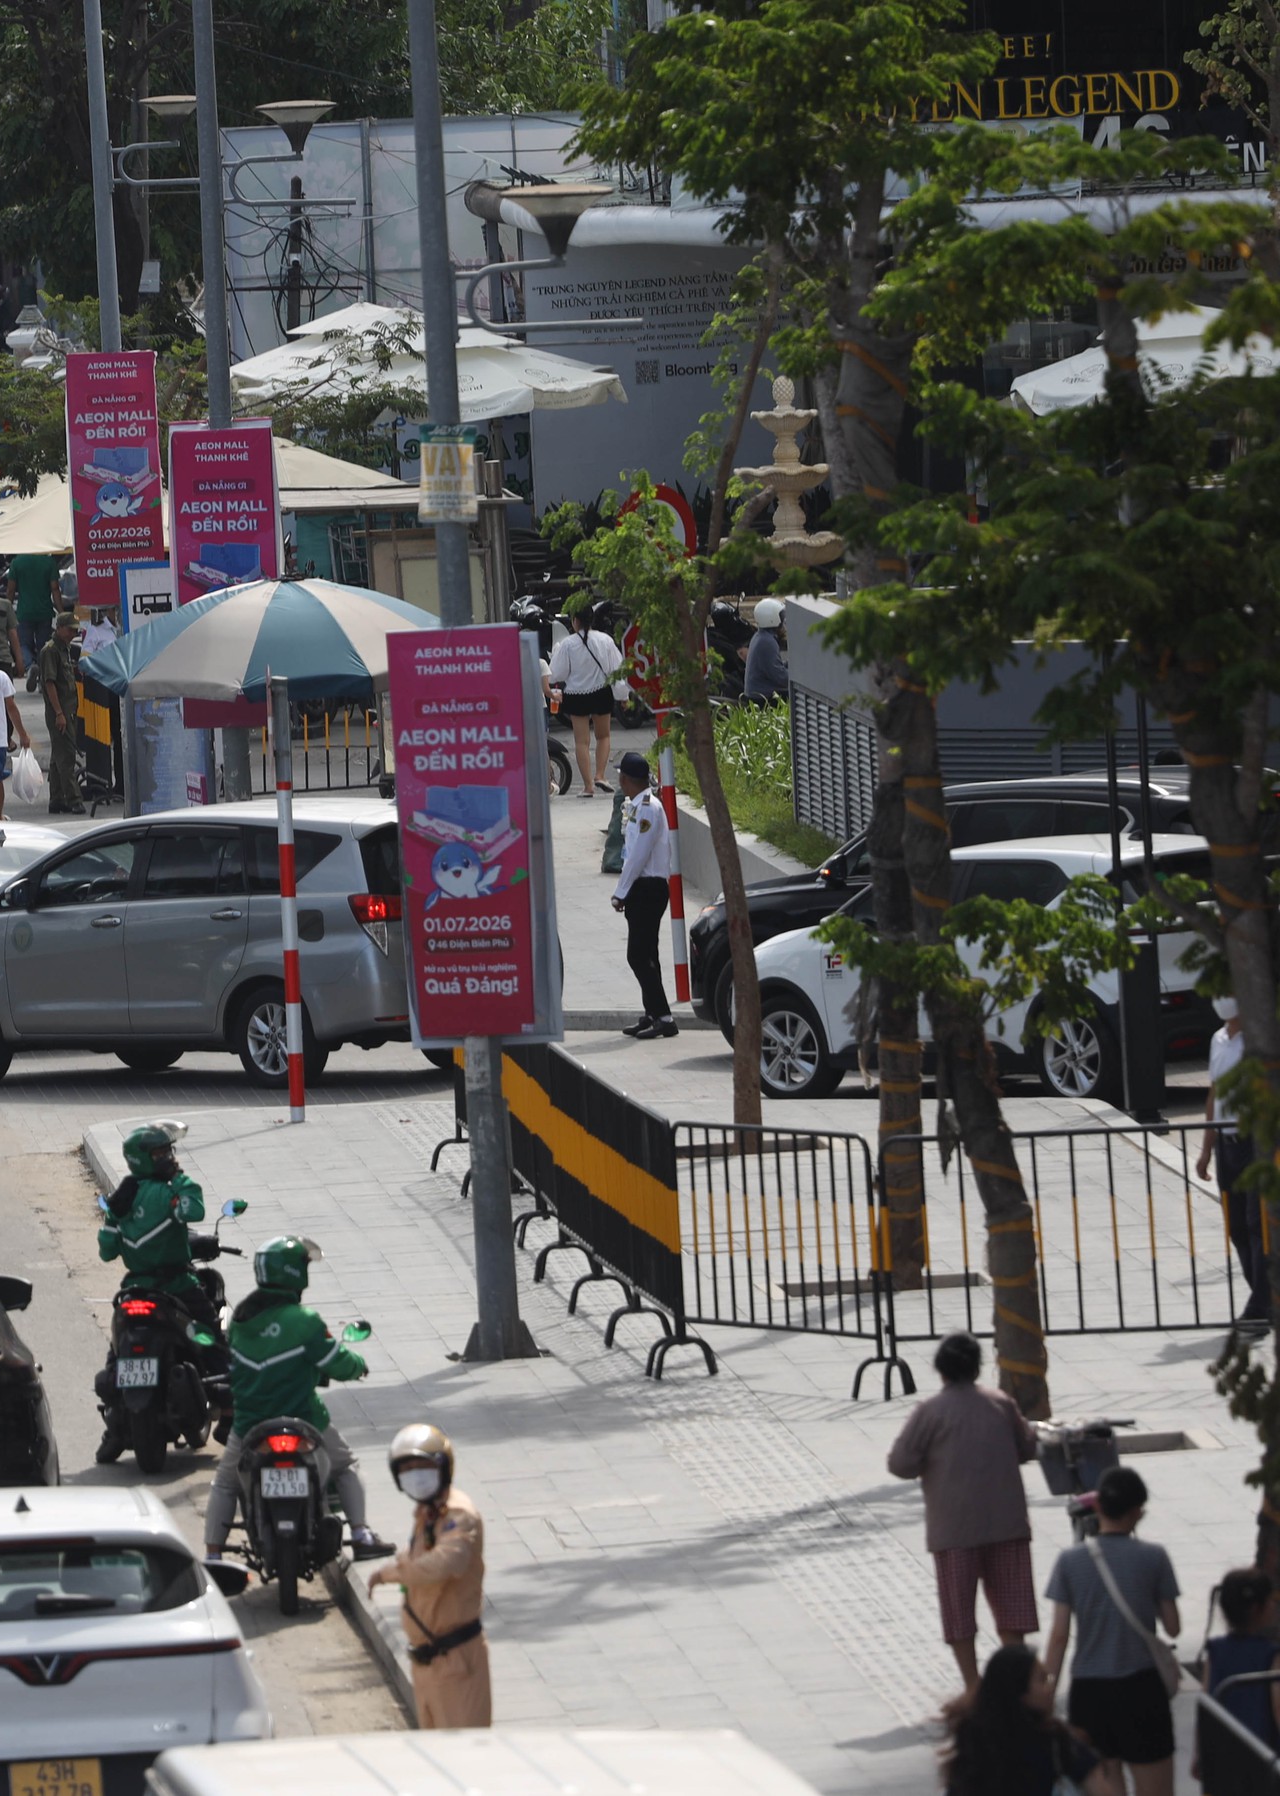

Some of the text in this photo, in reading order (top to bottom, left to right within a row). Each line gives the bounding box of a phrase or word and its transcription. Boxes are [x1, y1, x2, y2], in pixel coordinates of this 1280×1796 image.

[994, 70, 1181, 119] LEGEND
[577, 280, 622, 293] NGUYÊN
[625, 277, 666, 290] LEGEND
[624, 290, 666, 304] NGHIỆM
[669, 288, 684, 300] CÀ
[688, 287, 708, 298] PHÊ
[711, 286, 725, 297] VÀ
[624, 306, 645, 317] YÊU
[649, 304, 683, 316] THÍCH
[686, 302, 715, 313] TRÊN
[87, 360, 137, 370] AEON MALL
[665, 362, 738, 377] Bloombg
[88, 370, 138, 380] THANH KHÊ
[75, 410, 154, 424] AEON MALL
[85, 422, 146, 439] ĐẾN RỒI!
[195, 441, 249, 450] AEON MALL
[195, 452, 248, 462] THANH KHÊ
[423, 446, 472, 476] VAY
[198, 481, 210, 491] ĐÀ
[180, 500, 268, 514] AEON MALL
[191, 514, 257, 532] ĐẾN RỒI!
[88, 527, 151, 539] 01.07.2026
[87, 565, 114, 578] Quá
[414, 646, 492, 658] AEON MALL
[415, 661, 492, 675] THANH KHÊ
[422, 702, 438, 714] ĐÀ
[398, 725, 518, 746] AEON MALL
[414, 746, 504, 771] ĐẾN RỒI!
[423, 915, 512, 932] 01.07.2026
[436, 937, 510, 949] 46 Điện Biên Phủ
[425, 976, 519, 995] Quá Đáng!
[37, 1760, 75, 1782] 43H
